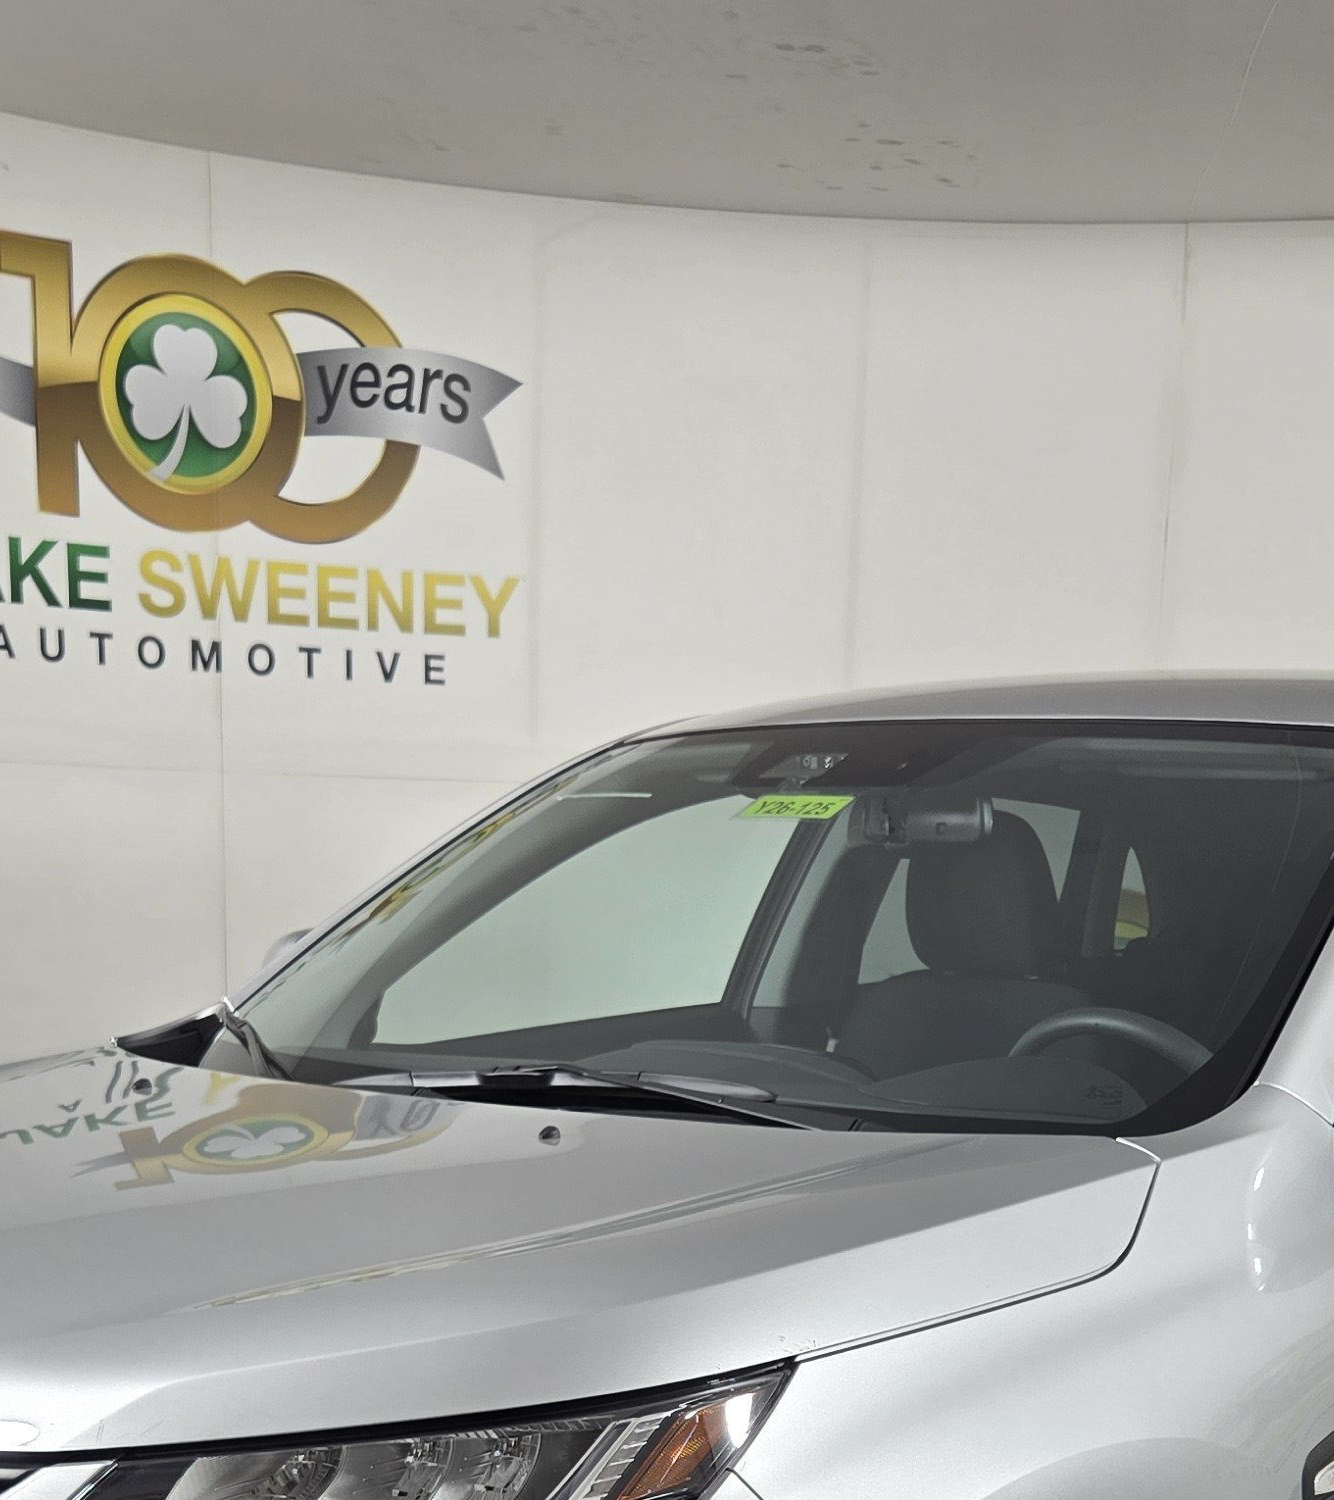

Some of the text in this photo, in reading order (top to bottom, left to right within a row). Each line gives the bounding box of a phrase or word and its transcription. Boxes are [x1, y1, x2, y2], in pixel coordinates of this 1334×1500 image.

[315, 360, 473, 425] years
[137, 549, 521, 639] SWEENEY
[753, 800, 837, 816] Y26-125
